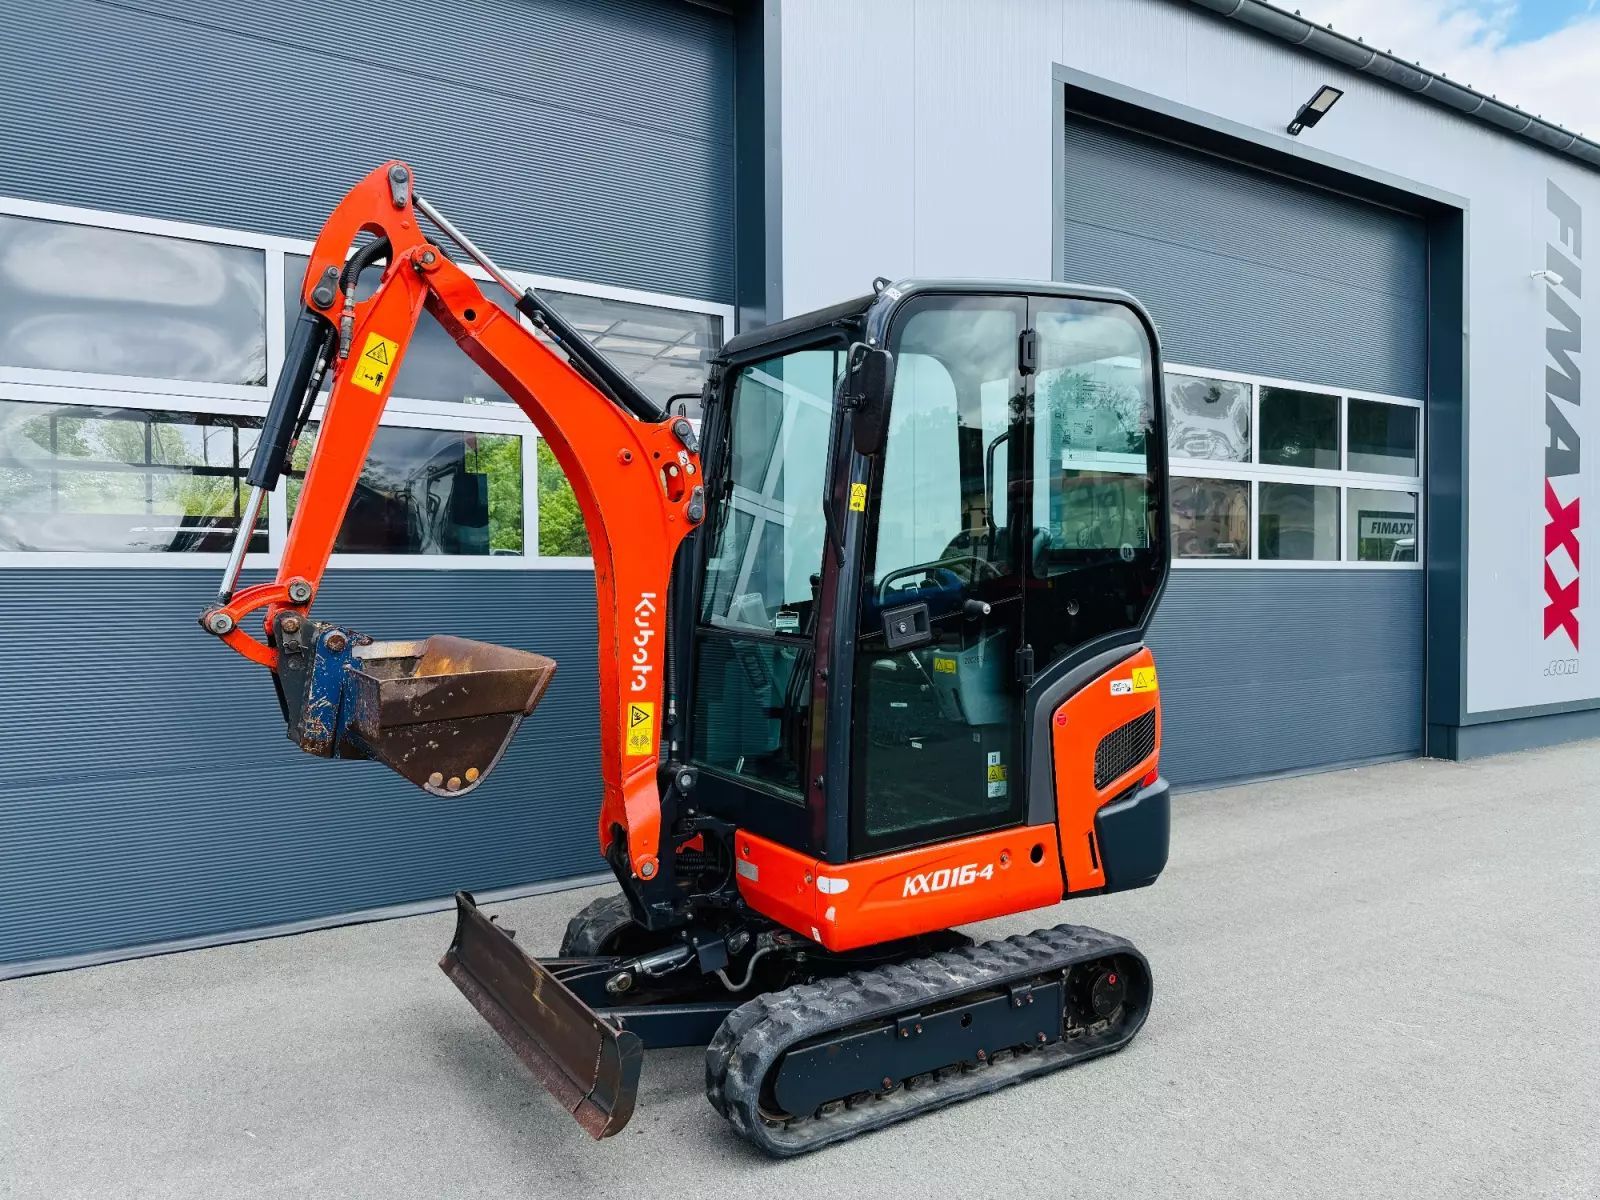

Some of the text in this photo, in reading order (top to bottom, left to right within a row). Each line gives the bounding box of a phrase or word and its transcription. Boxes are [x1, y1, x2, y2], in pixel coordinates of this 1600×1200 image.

[1544, 178, 1582, 652] FIMAXX
[1370, 521, 1414, 535] FIMAXX
[630, 592, 656, 691] Kubota
[1543, 658, 1579, 676] .com
